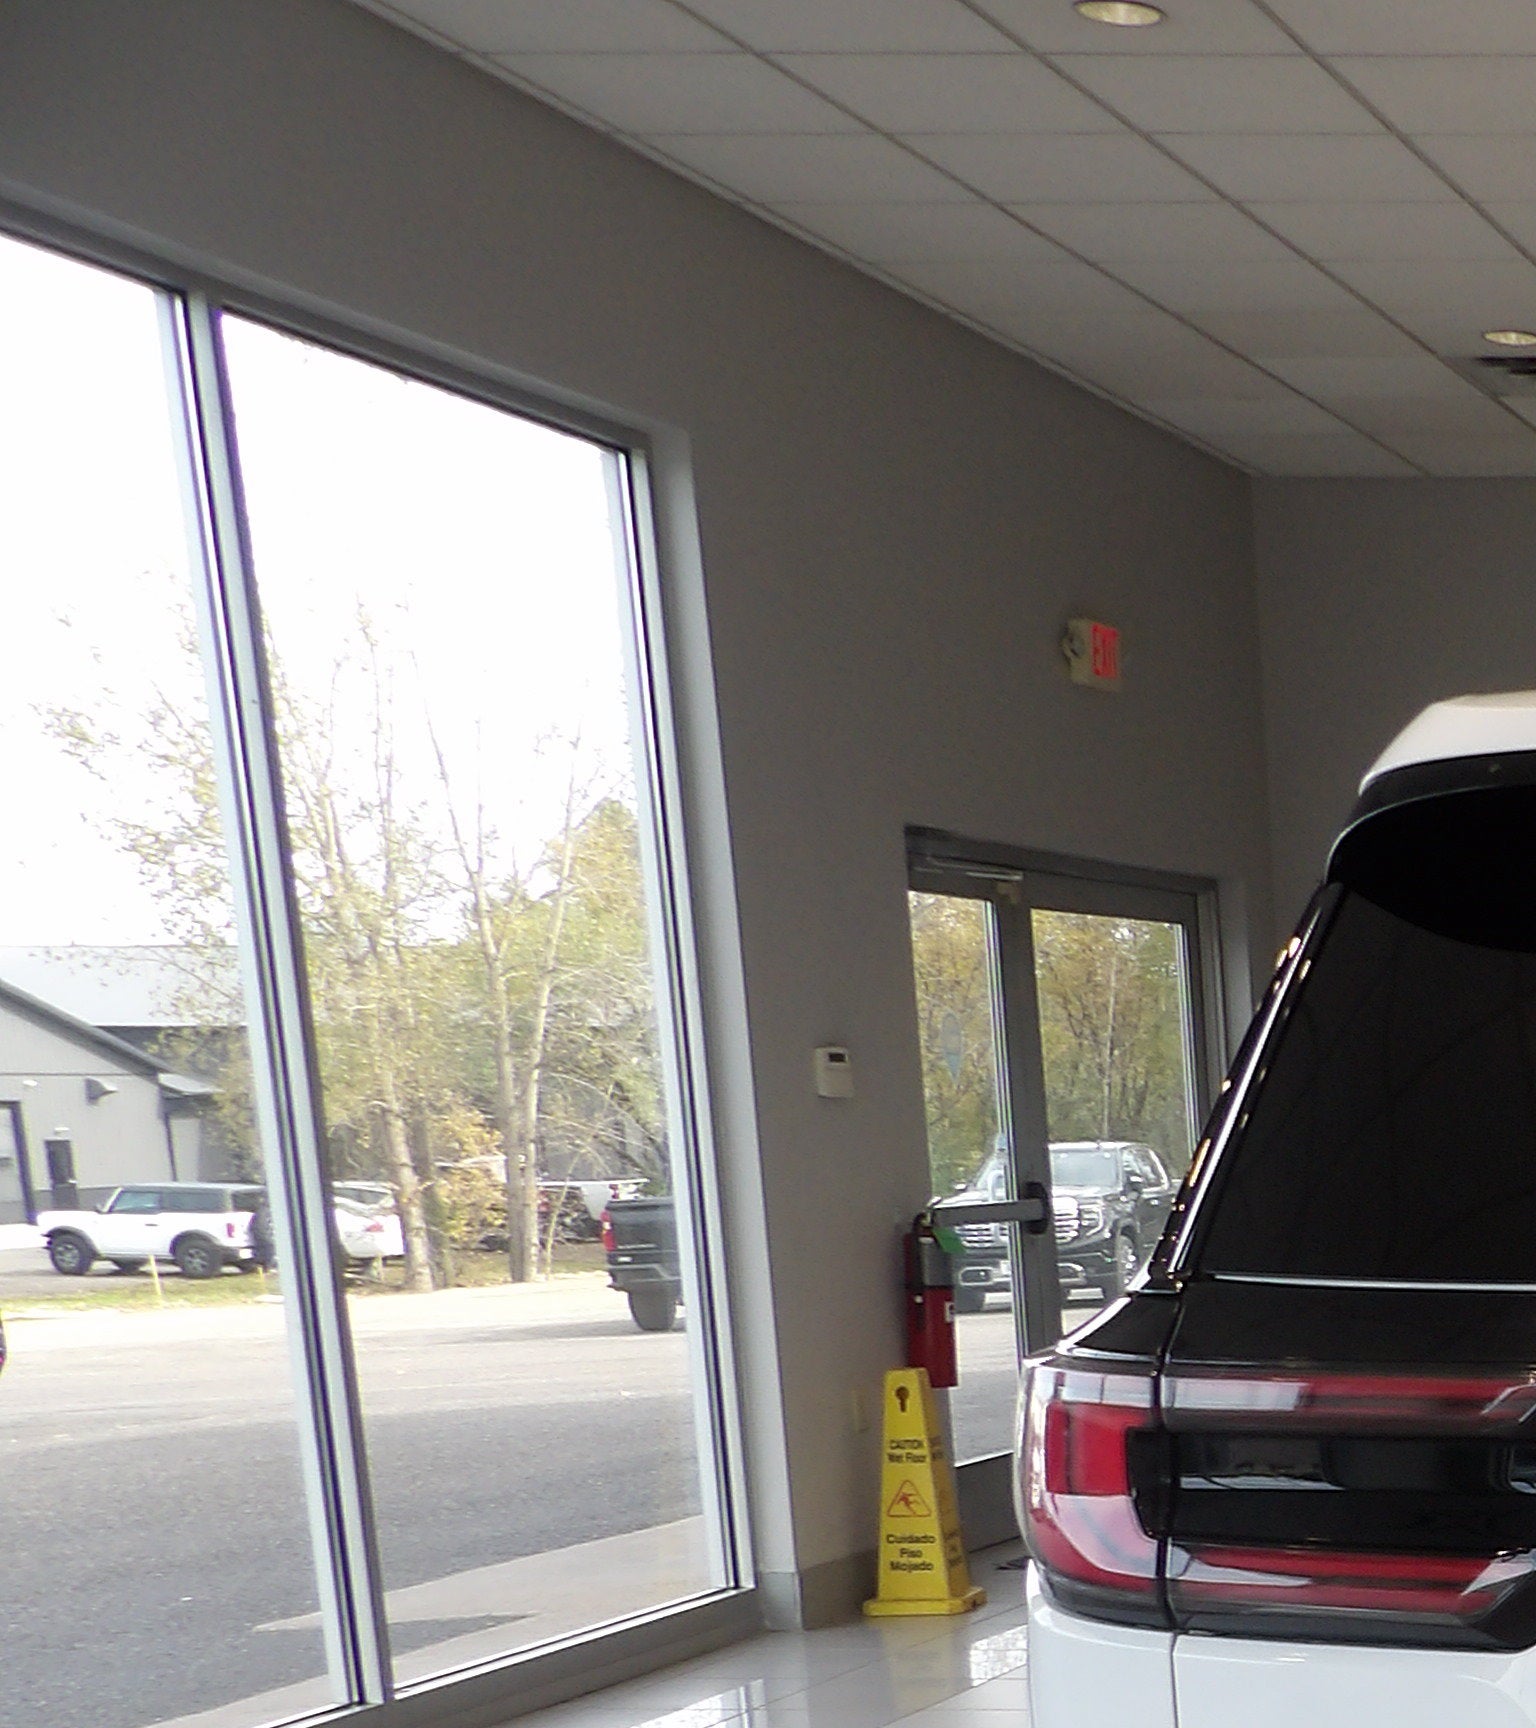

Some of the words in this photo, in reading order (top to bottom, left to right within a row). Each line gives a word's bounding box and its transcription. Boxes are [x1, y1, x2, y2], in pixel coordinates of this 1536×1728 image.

[886, 1533, 936, 1544] Cuidado
[899, 1548, 923, 1558] Piso
[890, 1560, 934, 1573] Mojado
